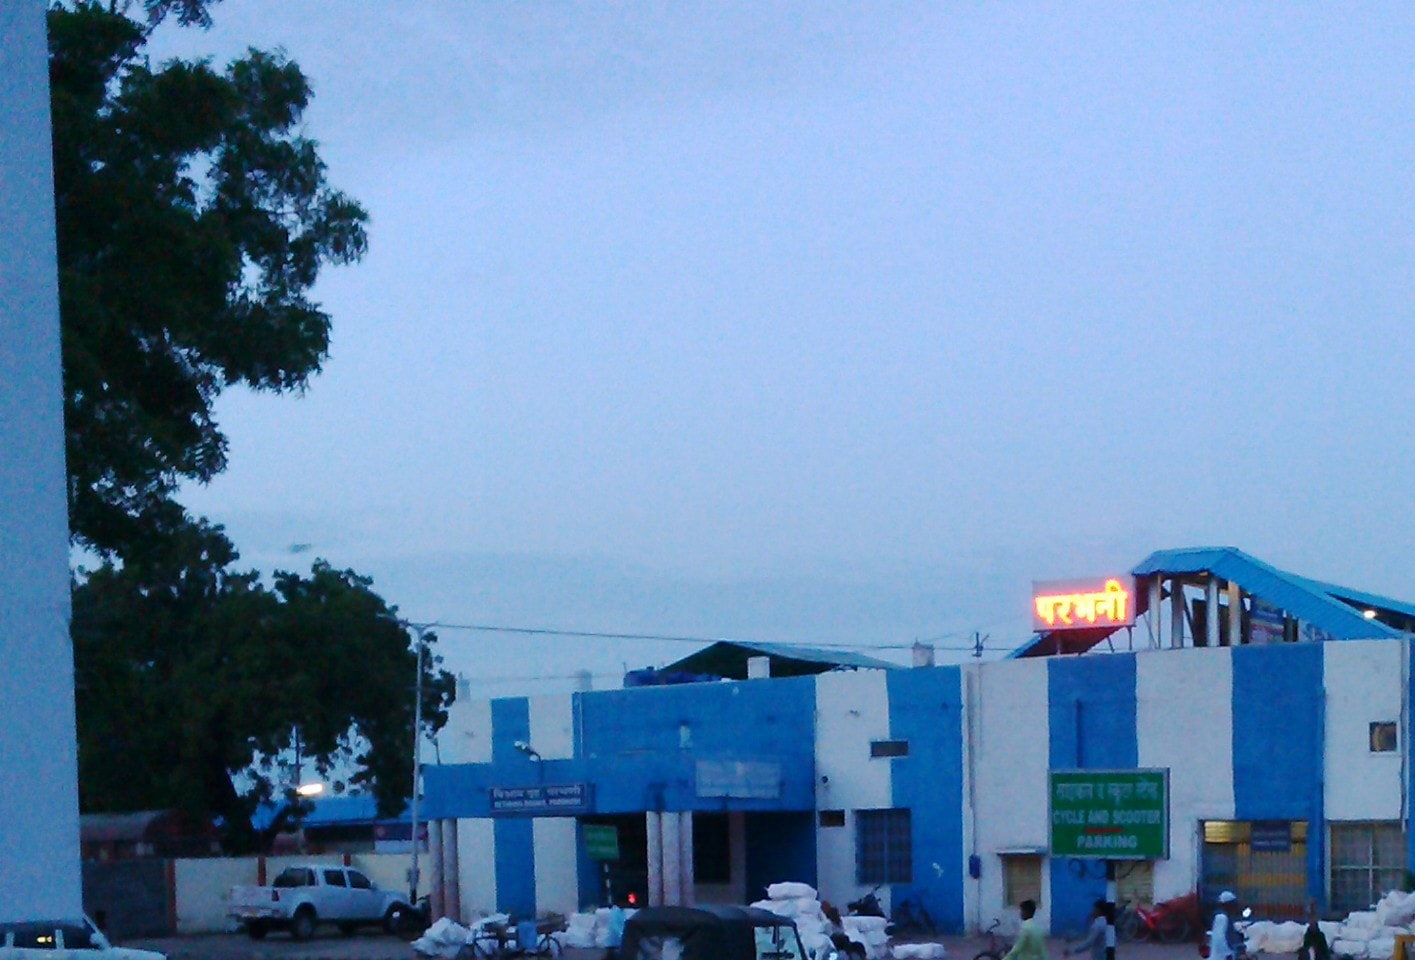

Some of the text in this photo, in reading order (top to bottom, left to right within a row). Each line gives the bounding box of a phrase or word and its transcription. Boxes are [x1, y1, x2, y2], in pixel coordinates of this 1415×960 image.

[1053, 809, 1161, 825] CYCLE AND SCOOTER
[1076, 835, 1138, 849] PARKING
